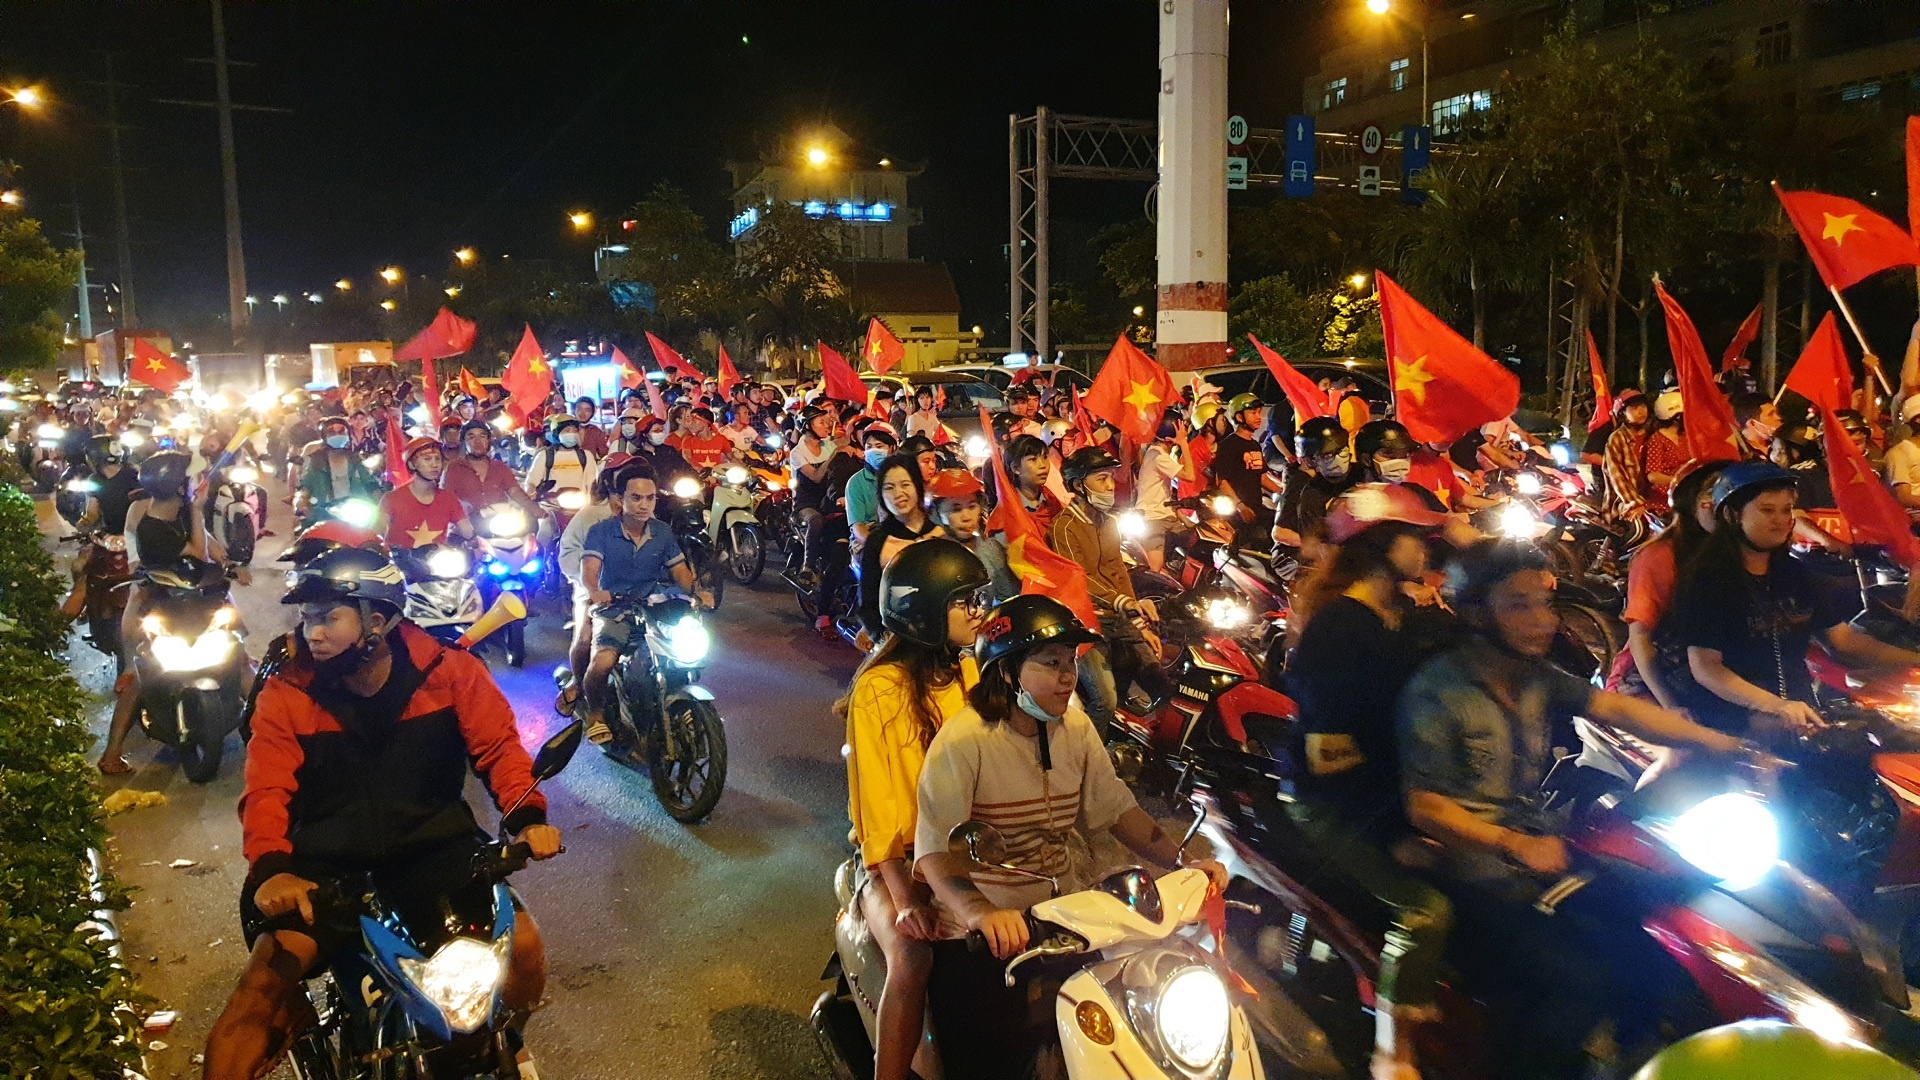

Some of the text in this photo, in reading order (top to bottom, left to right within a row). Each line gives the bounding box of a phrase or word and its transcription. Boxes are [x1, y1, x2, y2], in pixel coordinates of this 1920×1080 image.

[1230, 121, 1243, 138] 80
[1365, 131, 1377, 148] 60
[1178, 683, 1210, 702] YAMAHA
